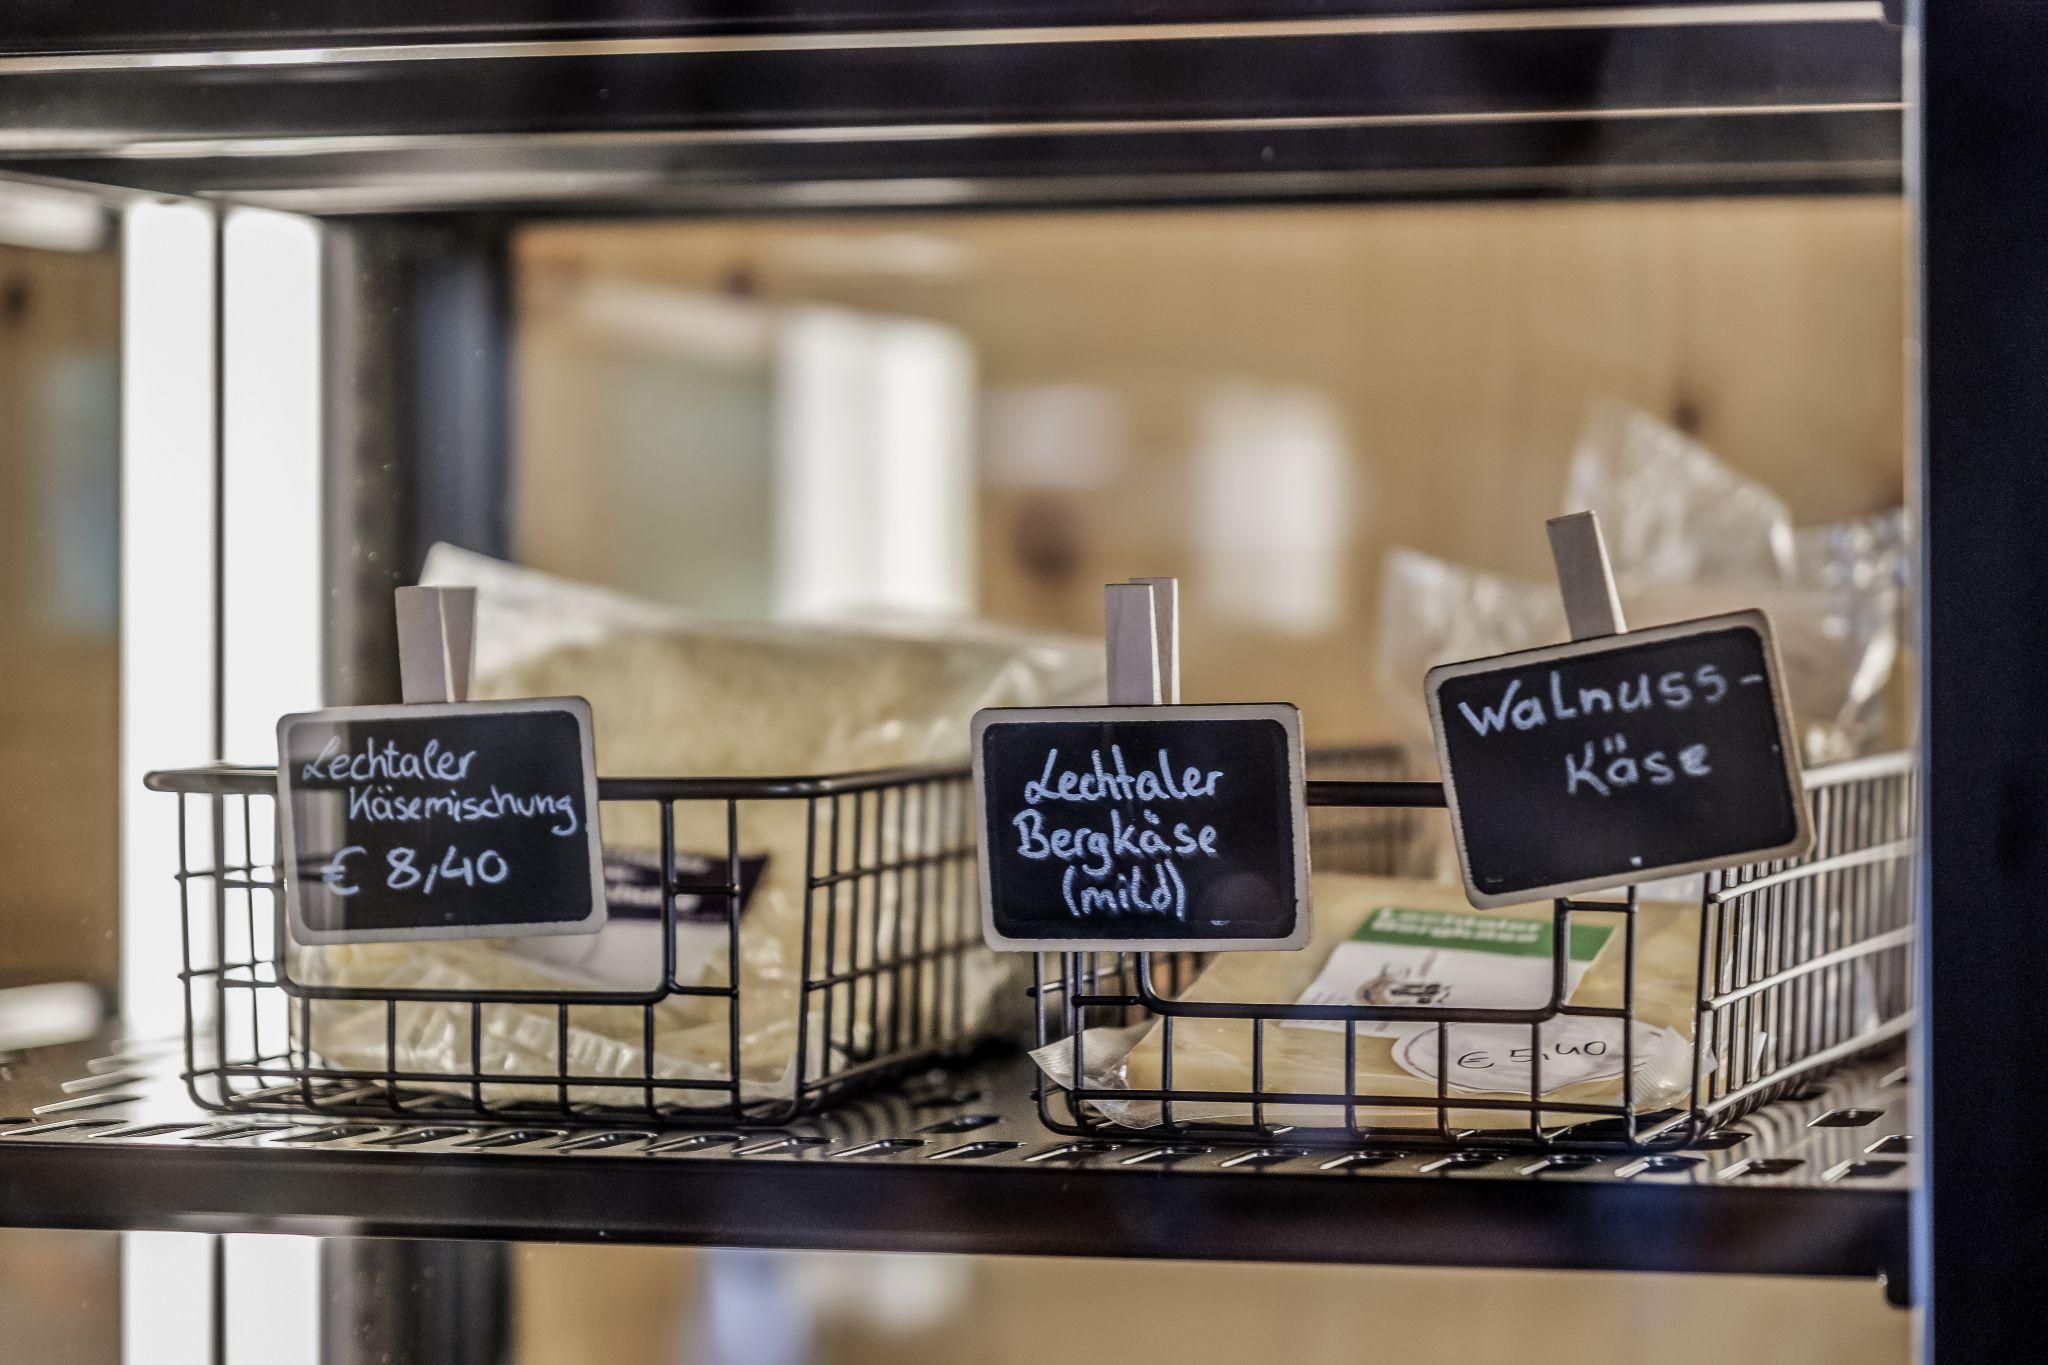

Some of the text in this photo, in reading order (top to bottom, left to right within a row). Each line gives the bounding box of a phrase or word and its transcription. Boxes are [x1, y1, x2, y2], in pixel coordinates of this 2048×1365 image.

[1458, 663, 1763, 737] Walnuss-
[302, 736, 476, 782] Lechtaler
[1024, 744, 1224, 804] Lechtaler
[1565, 733, 1712, 796] Käse
[350, 784, 578, 836] Käsemischung
[319, 845, 508, 895] € 8,40
[1012, 808, 1218, 877] Bergkäse
[1062, 859, 1186, 921] (mild)
[1457, 1051, 1494, 1069] €
